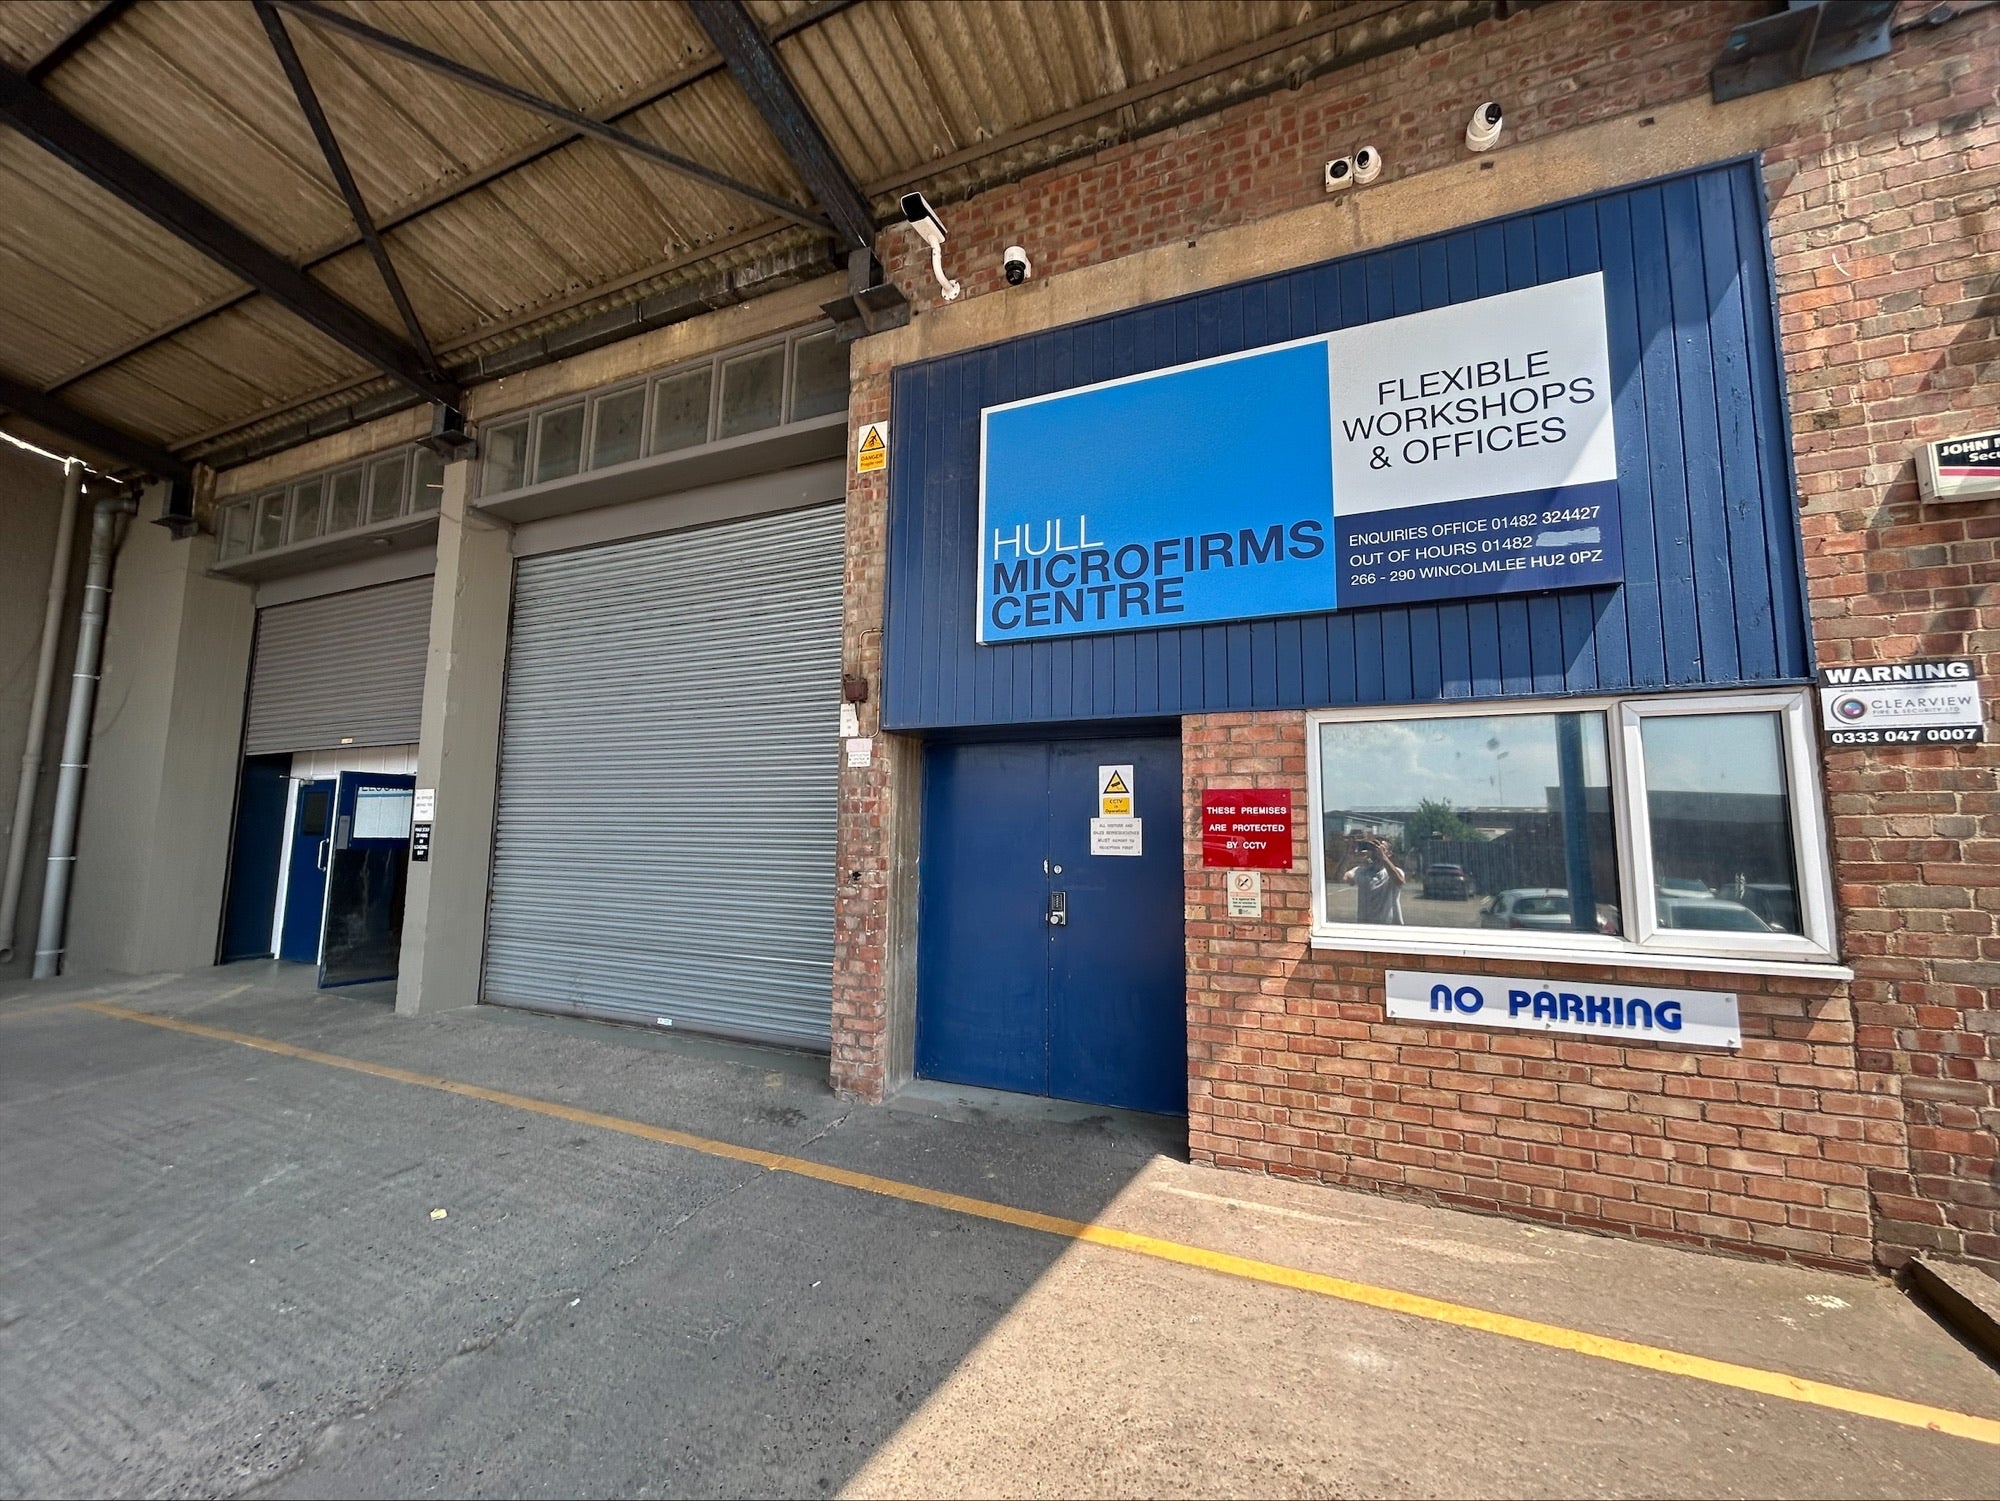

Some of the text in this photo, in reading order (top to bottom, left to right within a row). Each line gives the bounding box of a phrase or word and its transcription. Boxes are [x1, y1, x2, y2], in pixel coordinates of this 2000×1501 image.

[1378, 351, 1550, 405] FLEXIBLE
[1343, 377, 1595, 442] WORKSHOPS
[1369, 417, 1567, 470] & OFFICES
[1941, 439, 1989, 456] JOHN
[993, 514, 1104, 561] HULL
[1349, 505, 1600, 547] ENQUIRIES OFFICE 01482 324427
[993, 519, 1325, 595] MICROFIRMS
[1350, 536, 1533, 567] OUT OF HOURS 01482
[1351, 573, 1376, 586] 266
[1389, 569, 1416, 583] 290
[1418, 557, 1526, 579] WINCOLMLEE
[1531, 553, 1565, 568] HU2
[1570, 550, 1603, 564] 0PZ
[992, 577, 1184, 630] CENTRE
[1825, 662, 1970, 684] WARNING
[1871, 696, 1972, 709] CLEARVIEW
[1831, 728, 1977, 744] 0333 047 0007
[1206, 806, 1287, 815] THESE PREMISES
[1209, 824, 1285, 832] ARE PROTECTED
[1430, 983, 1682, 1032] NO PARKING
